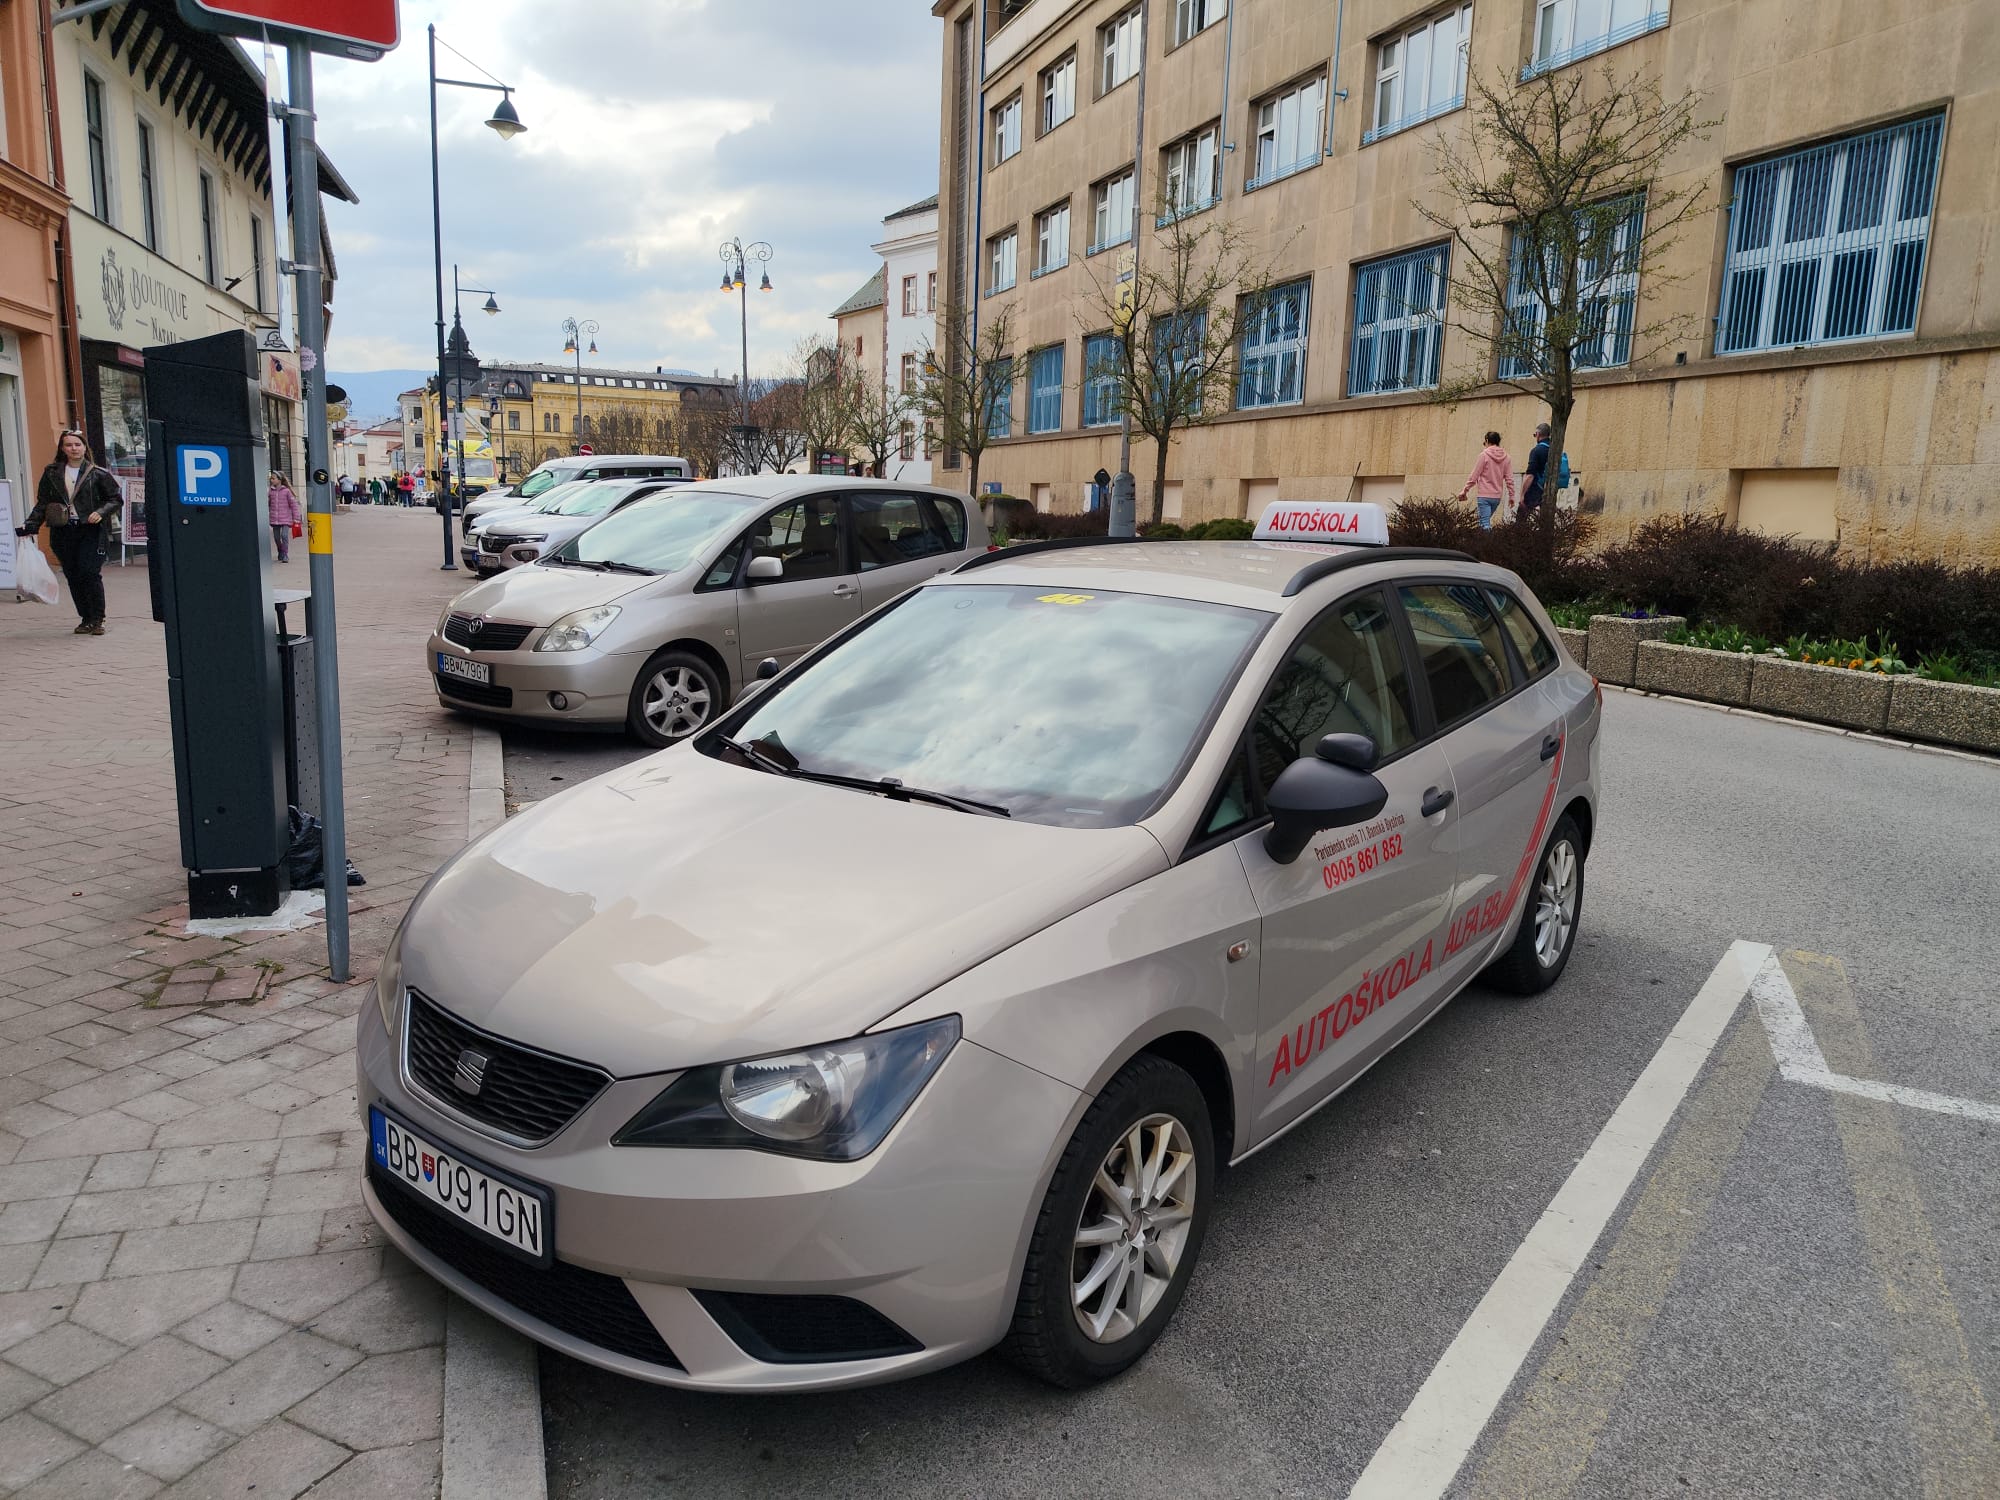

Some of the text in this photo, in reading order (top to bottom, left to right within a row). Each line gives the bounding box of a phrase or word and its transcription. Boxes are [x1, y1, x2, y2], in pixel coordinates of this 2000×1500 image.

[130, 267, 188, 322] BOUTIQUE
[184, 449, 223, 494] P
[1268, 508, 1359, 534] AUTOŠKOLA
[1323, 833, 1403, 889] 0905 861 852
[1268, 938, 1434, 1089] AUTOŠKOLA
[1440, 903, 1481, 962] ALFA
